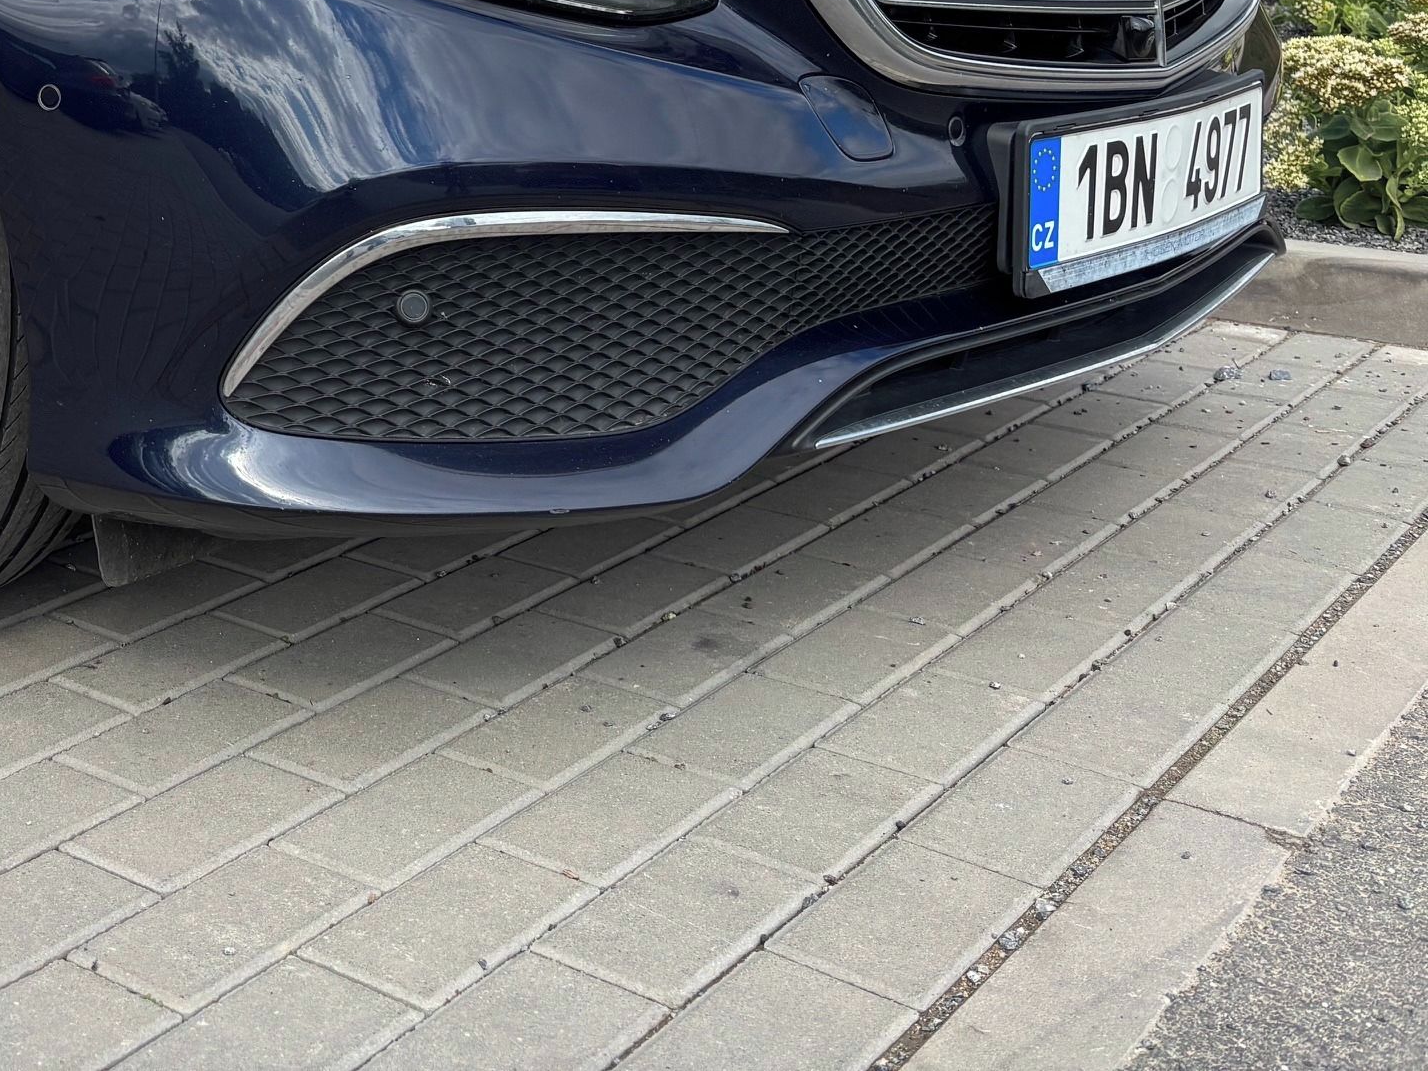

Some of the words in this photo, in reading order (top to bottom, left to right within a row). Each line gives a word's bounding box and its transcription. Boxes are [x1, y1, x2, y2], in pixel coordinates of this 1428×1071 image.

[1077, 132, 1158, 242] 1BN
[1185, 103, 1251, 212] 4977
[1031, 220, 1054, 252] CZ
